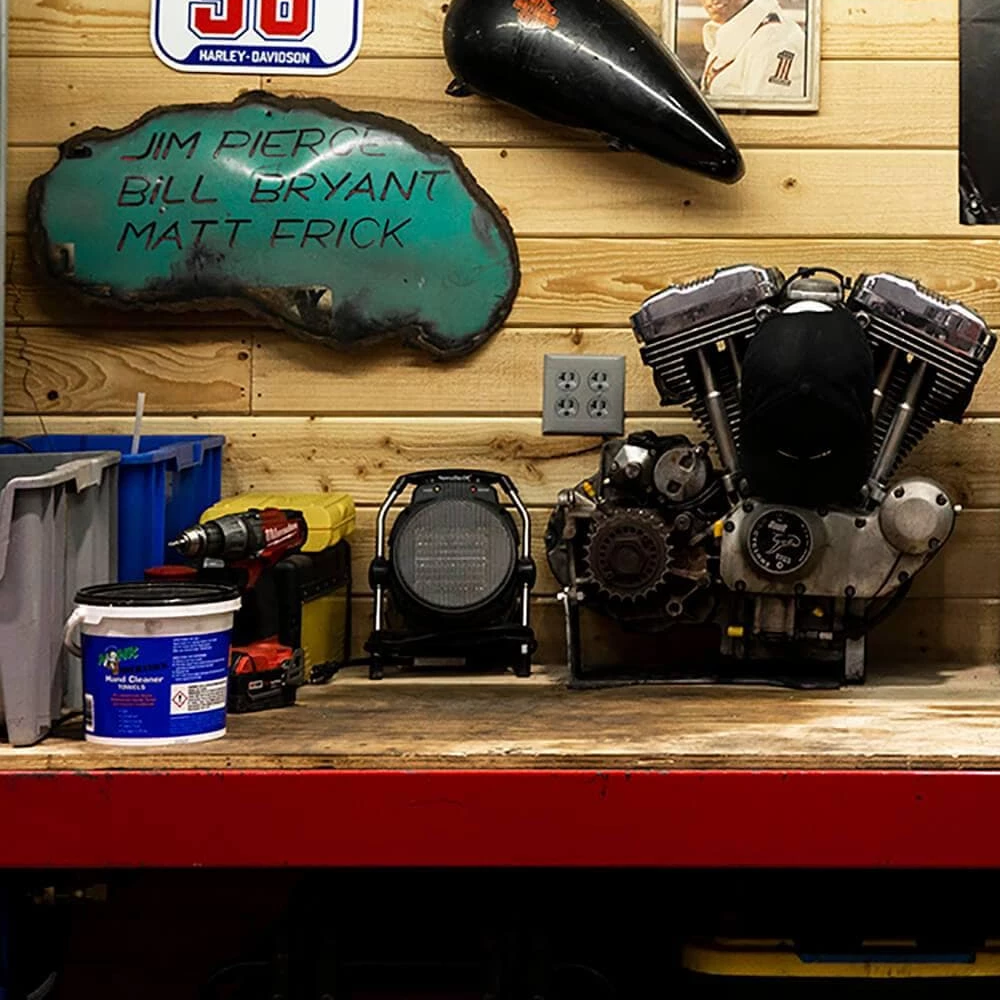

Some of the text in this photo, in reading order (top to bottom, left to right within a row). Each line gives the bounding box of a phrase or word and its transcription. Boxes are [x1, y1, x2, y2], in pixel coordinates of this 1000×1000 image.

[199, 49, 311, 65] HARLEY-DAVIDSON
[120, 126, 386, 160] JIM PIERCE
[250, 169, 451, 204] BRYANT
[116, 216, 413, 252] MATT FRICK
